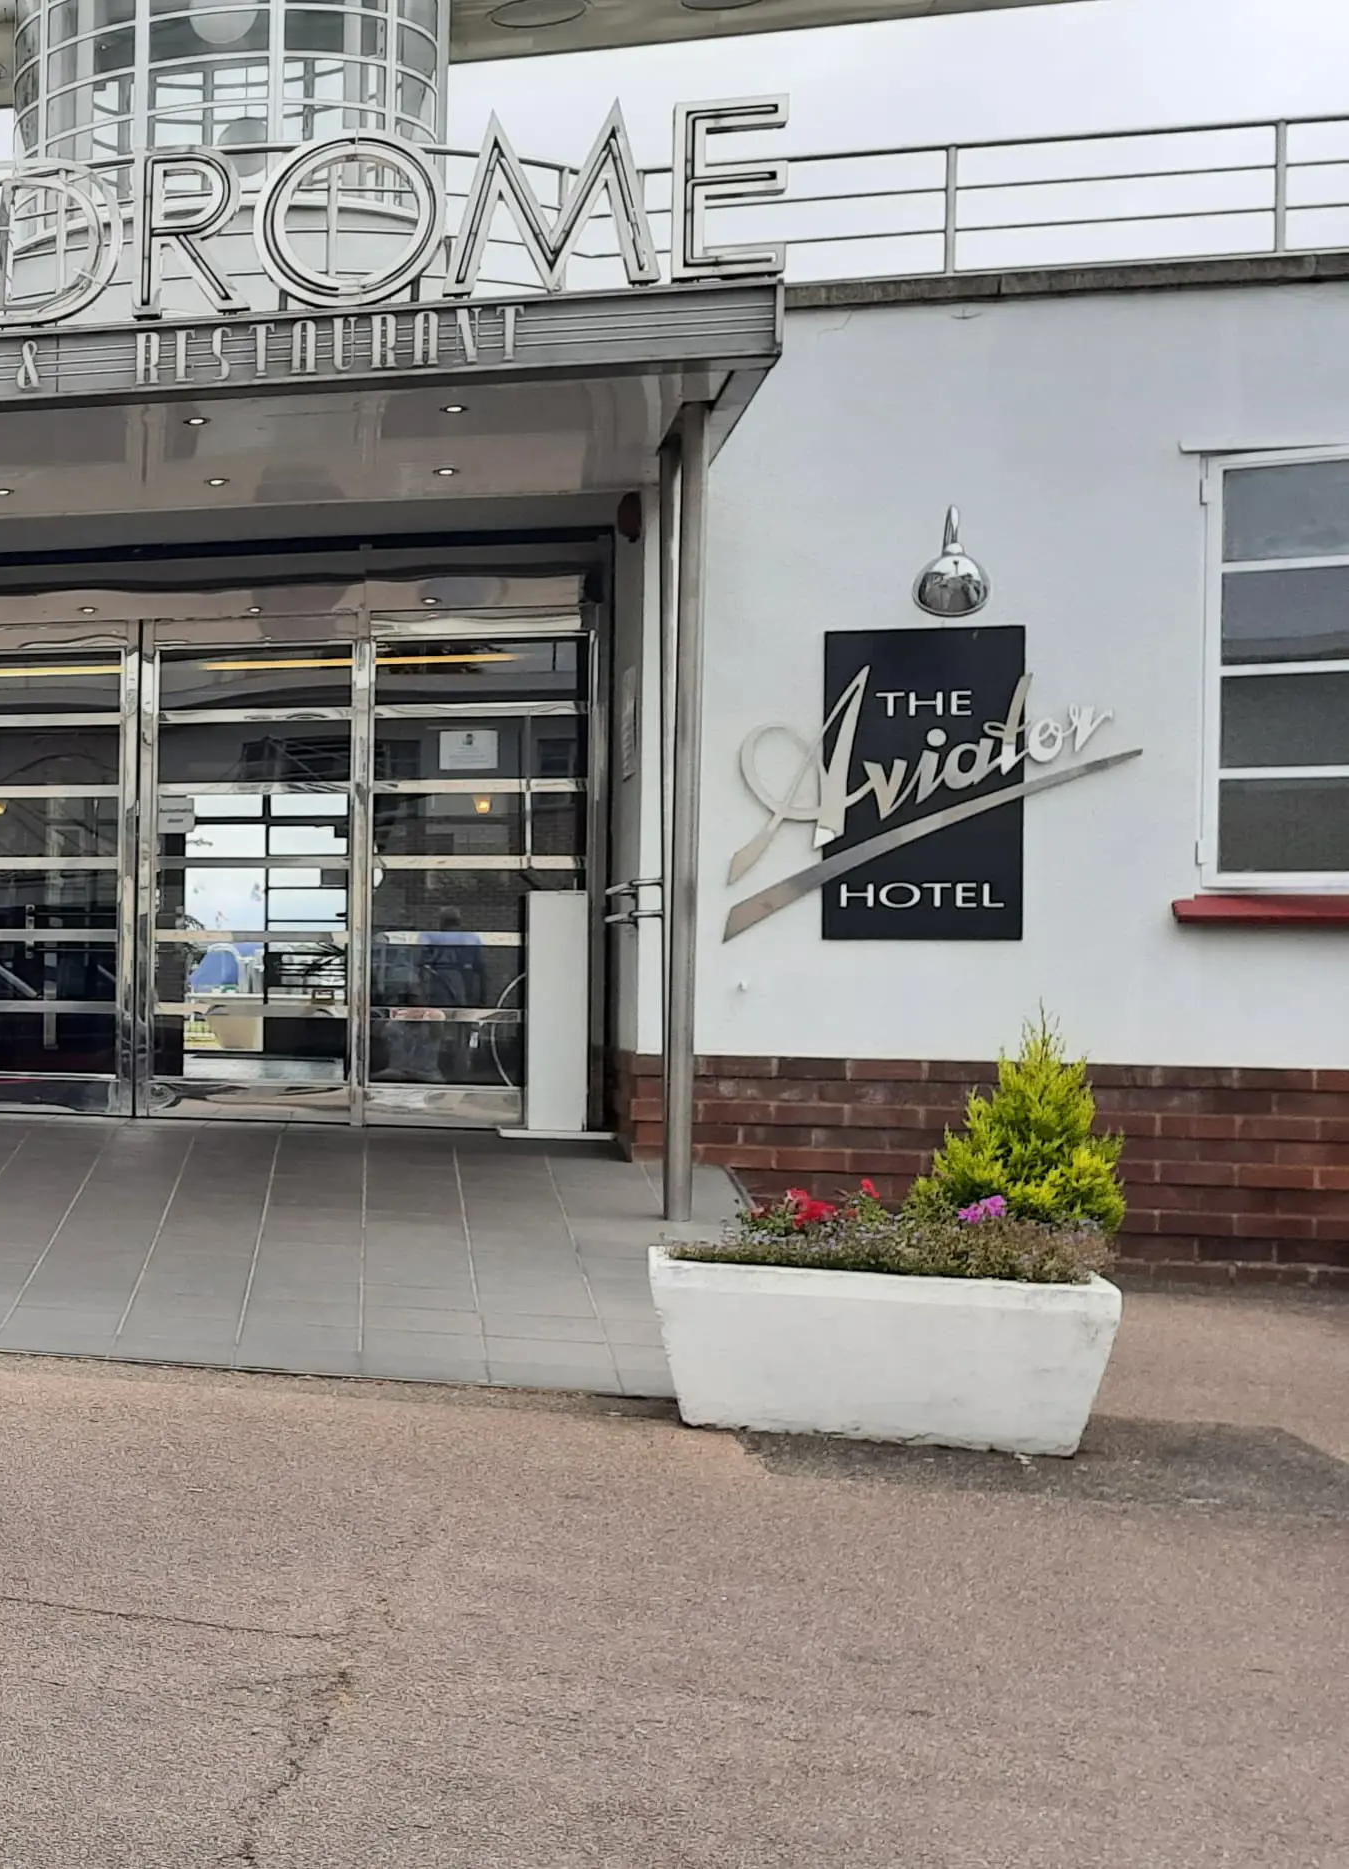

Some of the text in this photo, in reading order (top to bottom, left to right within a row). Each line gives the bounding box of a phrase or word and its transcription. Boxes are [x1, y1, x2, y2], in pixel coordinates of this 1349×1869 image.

[14, 339, 44, 393] &
[134, 304, 525, 386] RESTAURANT
[875, 690, 972, 717] THE
[727, 664, 1114, 887] Aviator
[839, 882, 1005, 909] HOTEL
